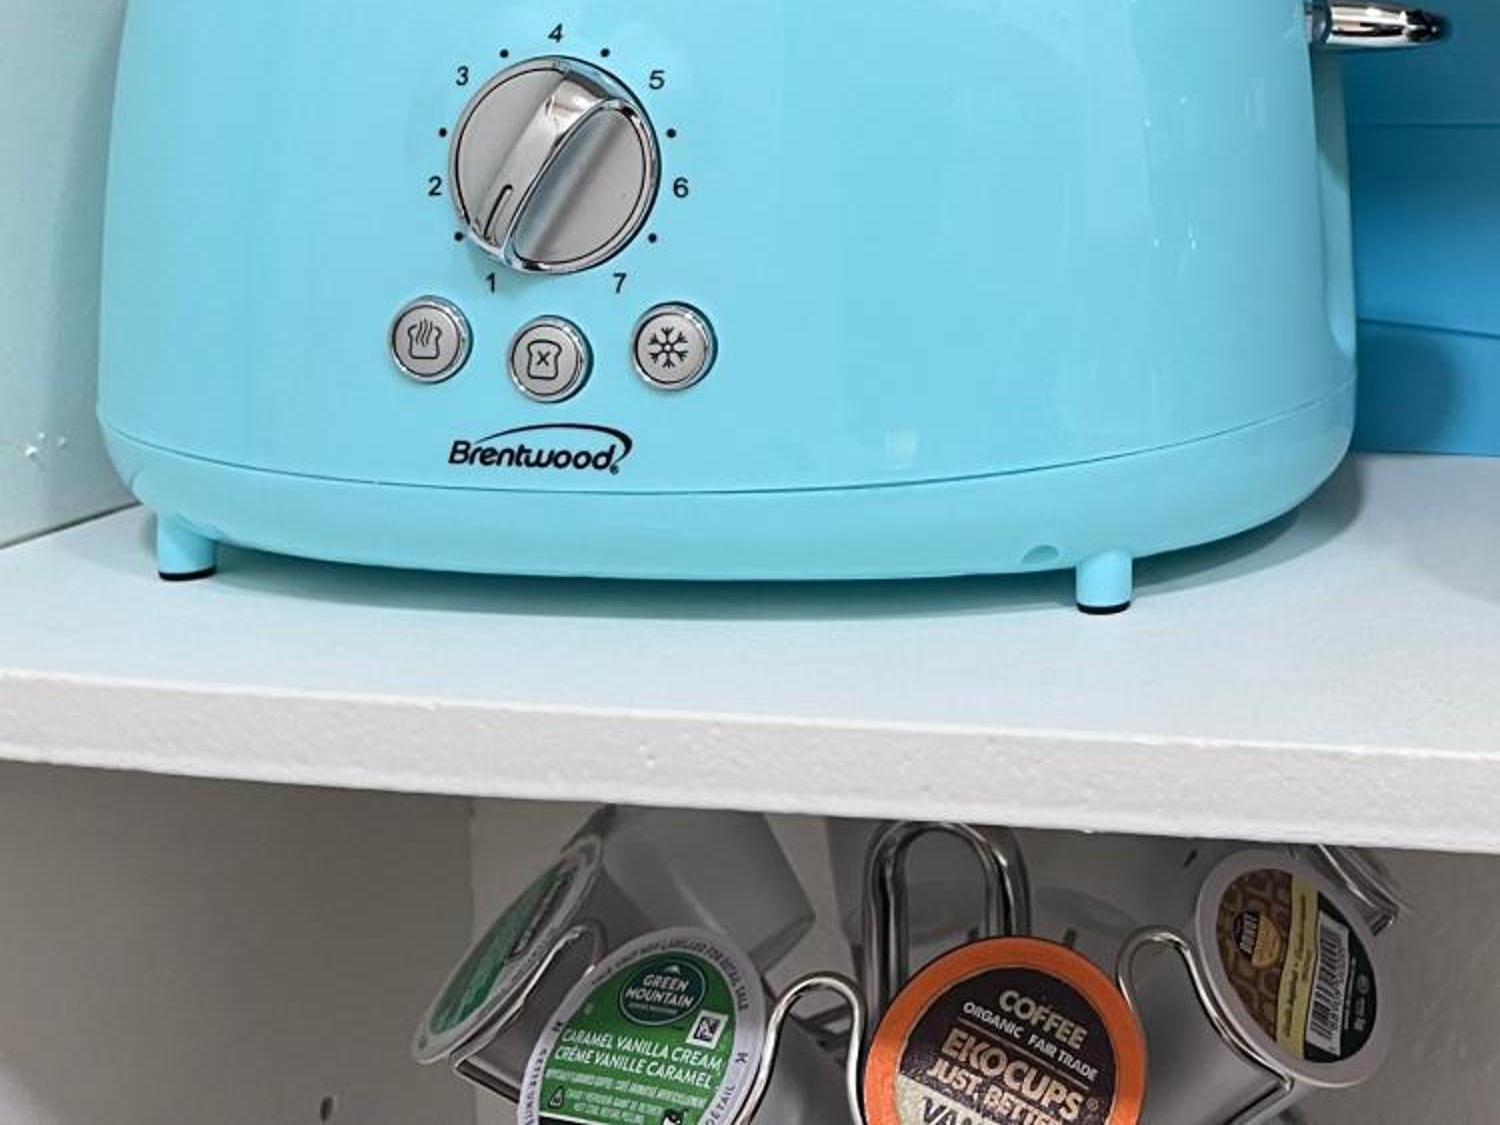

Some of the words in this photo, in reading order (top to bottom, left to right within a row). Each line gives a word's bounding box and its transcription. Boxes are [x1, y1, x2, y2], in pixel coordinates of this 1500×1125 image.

[547, 23, 564, 43] 4
[455, 67, 470, 86] 3
[649, 70, 666, 90] 5
[427, 178, 444, 196] 2
[673, 178, 690, 198] 6
[486, 274, 497, 293] 1
[612, 274, 628, 293] 7
[448, 440, 618, 470] Brentwood
[643, 973, 690, 992] GREEN
[625, 986, 695, 1008] MOUNTAIN
[999, 990, 1088, 1050] COFFEE
[562, 1028, 613, 1049] CARAMEL
[617, 1036, 669, 1058] VANILLA
[963, 1002, 1025, 1038] ORGANIC
[1027, 1033, 1058, 1058] FAIR
[1057, 1049, 1099, 1082] TRADE
[593, 1050, 647, 1074] VANILLE
[646, 1062, 711, 1089] CARAMEL
[941, 1027, 1084, 1122] EKOCUPS
